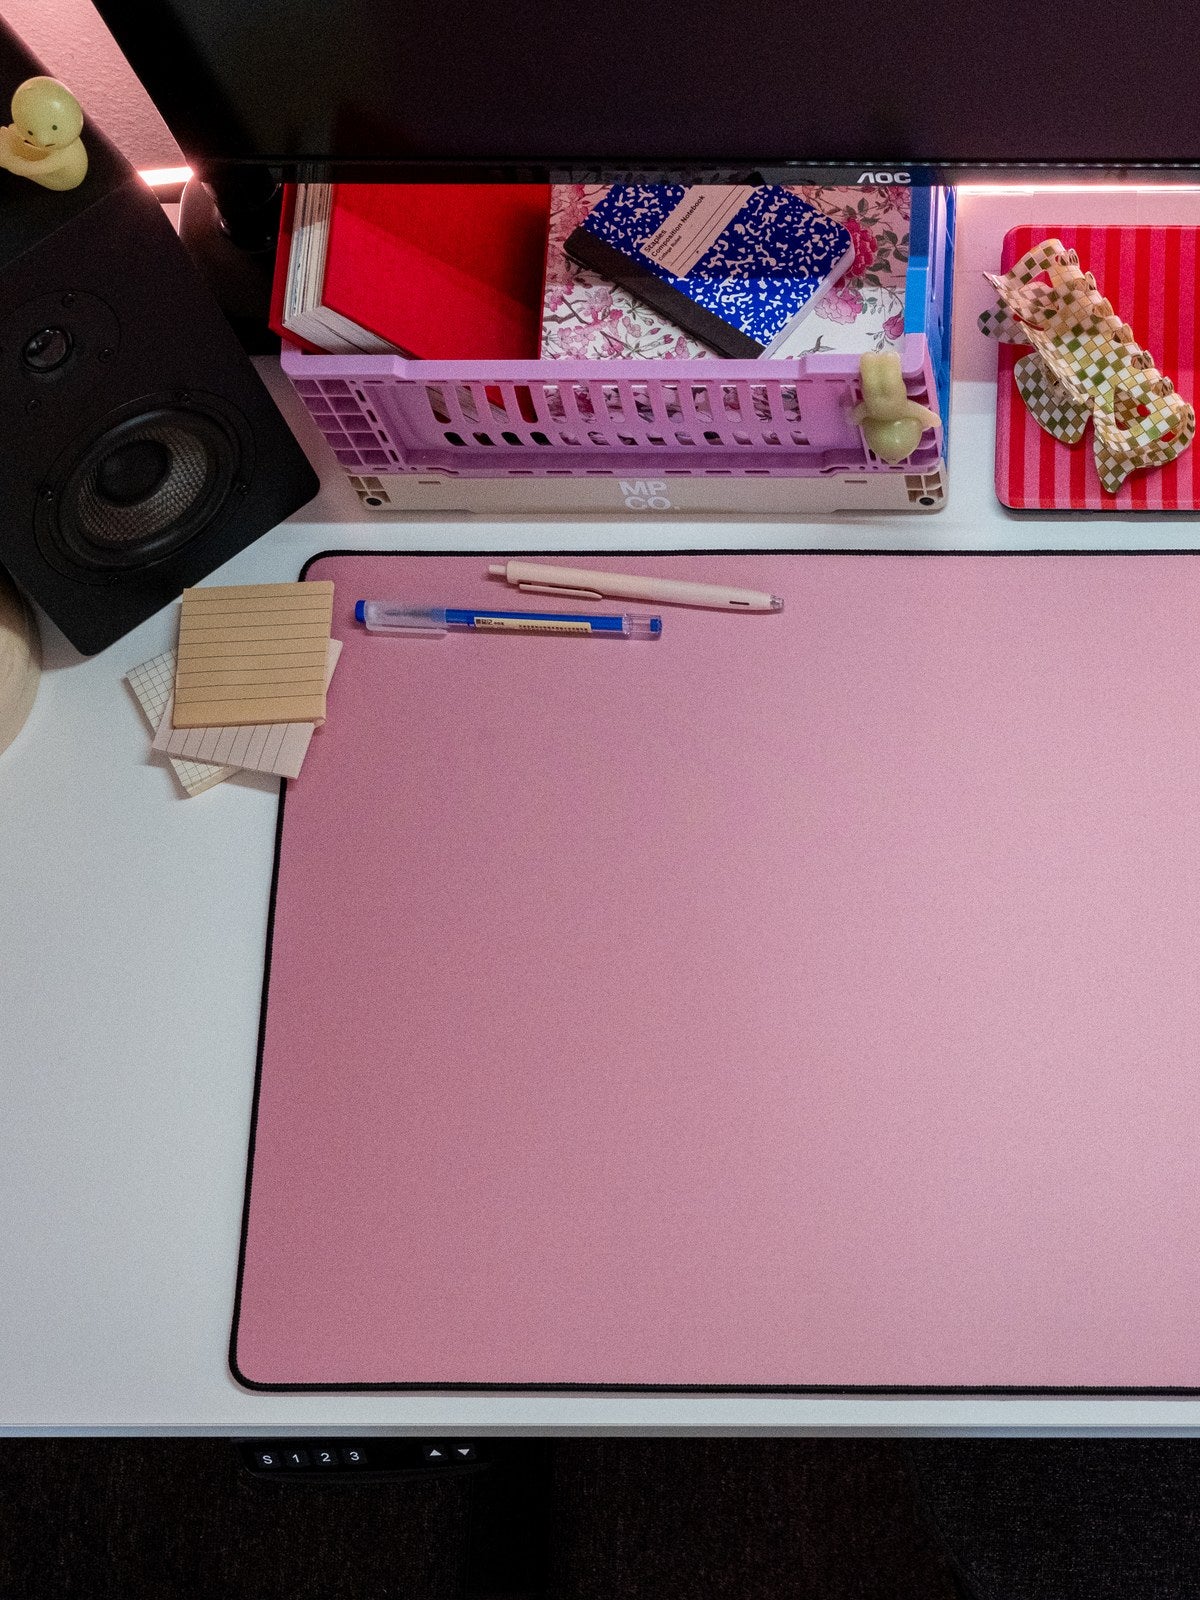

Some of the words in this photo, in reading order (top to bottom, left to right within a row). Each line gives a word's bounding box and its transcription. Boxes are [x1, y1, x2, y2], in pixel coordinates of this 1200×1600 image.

[857, 171, 911, 184] AOC
[651, 222, 683, 257] Composition
[680, 195, 706, 223] Notebook
[644, 229, 667, 253] Staples
[619, 481, 667, 496] MP
[262, 1455, 273, 1464] S
[292, 1454, 300, 1463] 1
[320, 1453, 331, 1462] 2
[349, 1451, 360, 1461] 3
